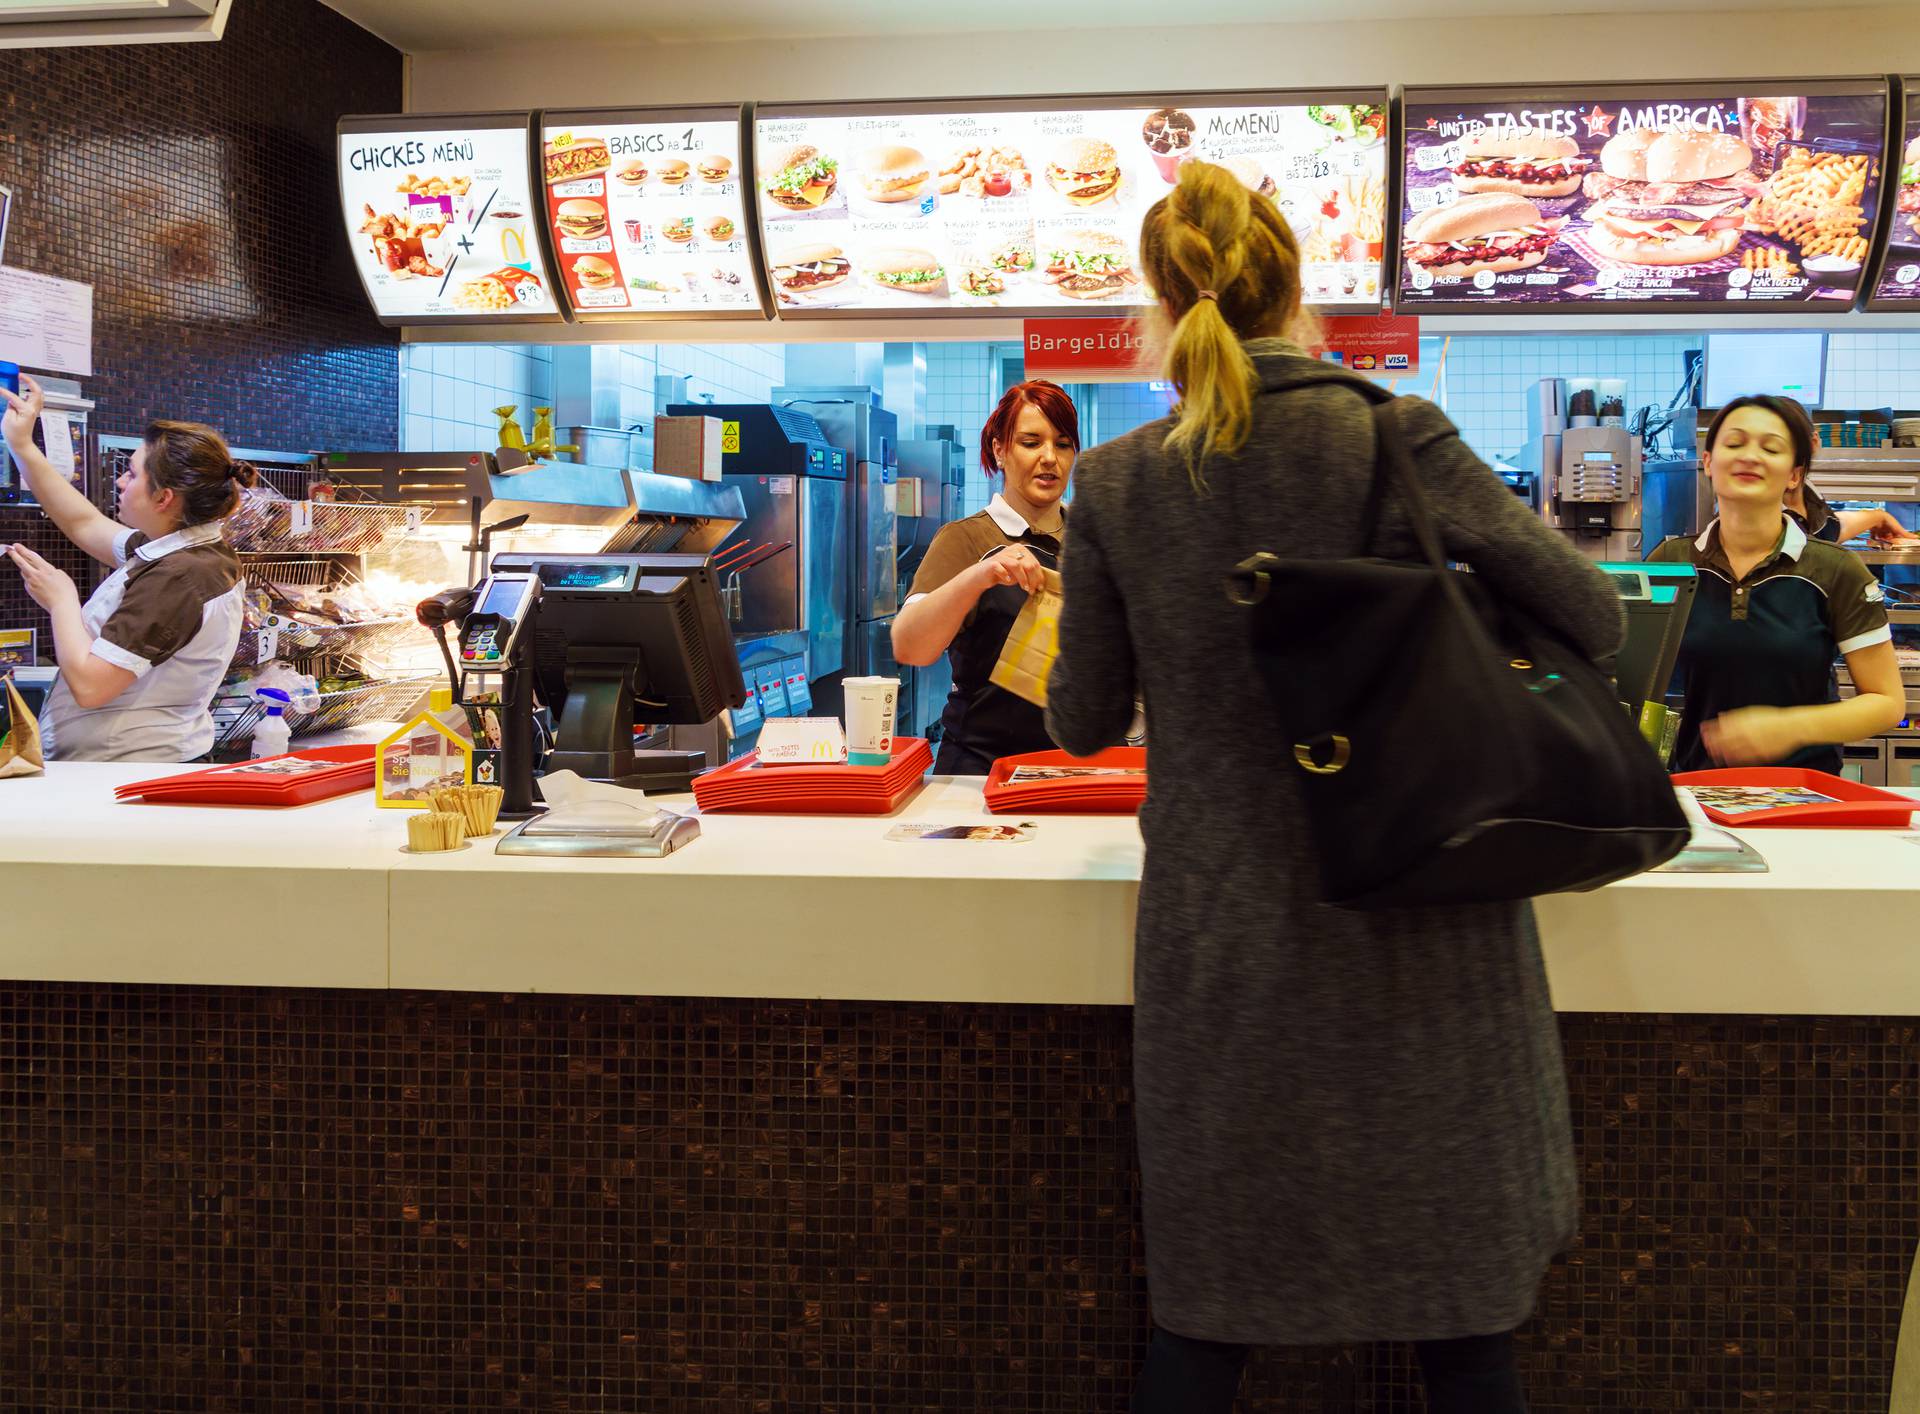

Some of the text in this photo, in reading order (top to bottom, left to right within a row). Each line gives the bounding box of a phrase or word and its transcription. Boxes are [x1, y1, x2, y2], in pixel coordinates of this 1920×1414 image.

[1208, 110, 1280, 136] McMENÜ
[1485, 109, 1577, 141] TASTES
[1591, 115, 1608, 130] OF
[554, 134, 572, 148] NEU!
[432, 138, 474, 163] MENÜ
[1292, 152, 1320, 166] SPARE
[1314, 161, 1330, 178] 28
[1030, 333, 1146, 353] Bargeldlo
[1388, 356, 1406, 364] VISA
[408, 512, 416, 531] 2
[392, 766, 409, 776] Sie
